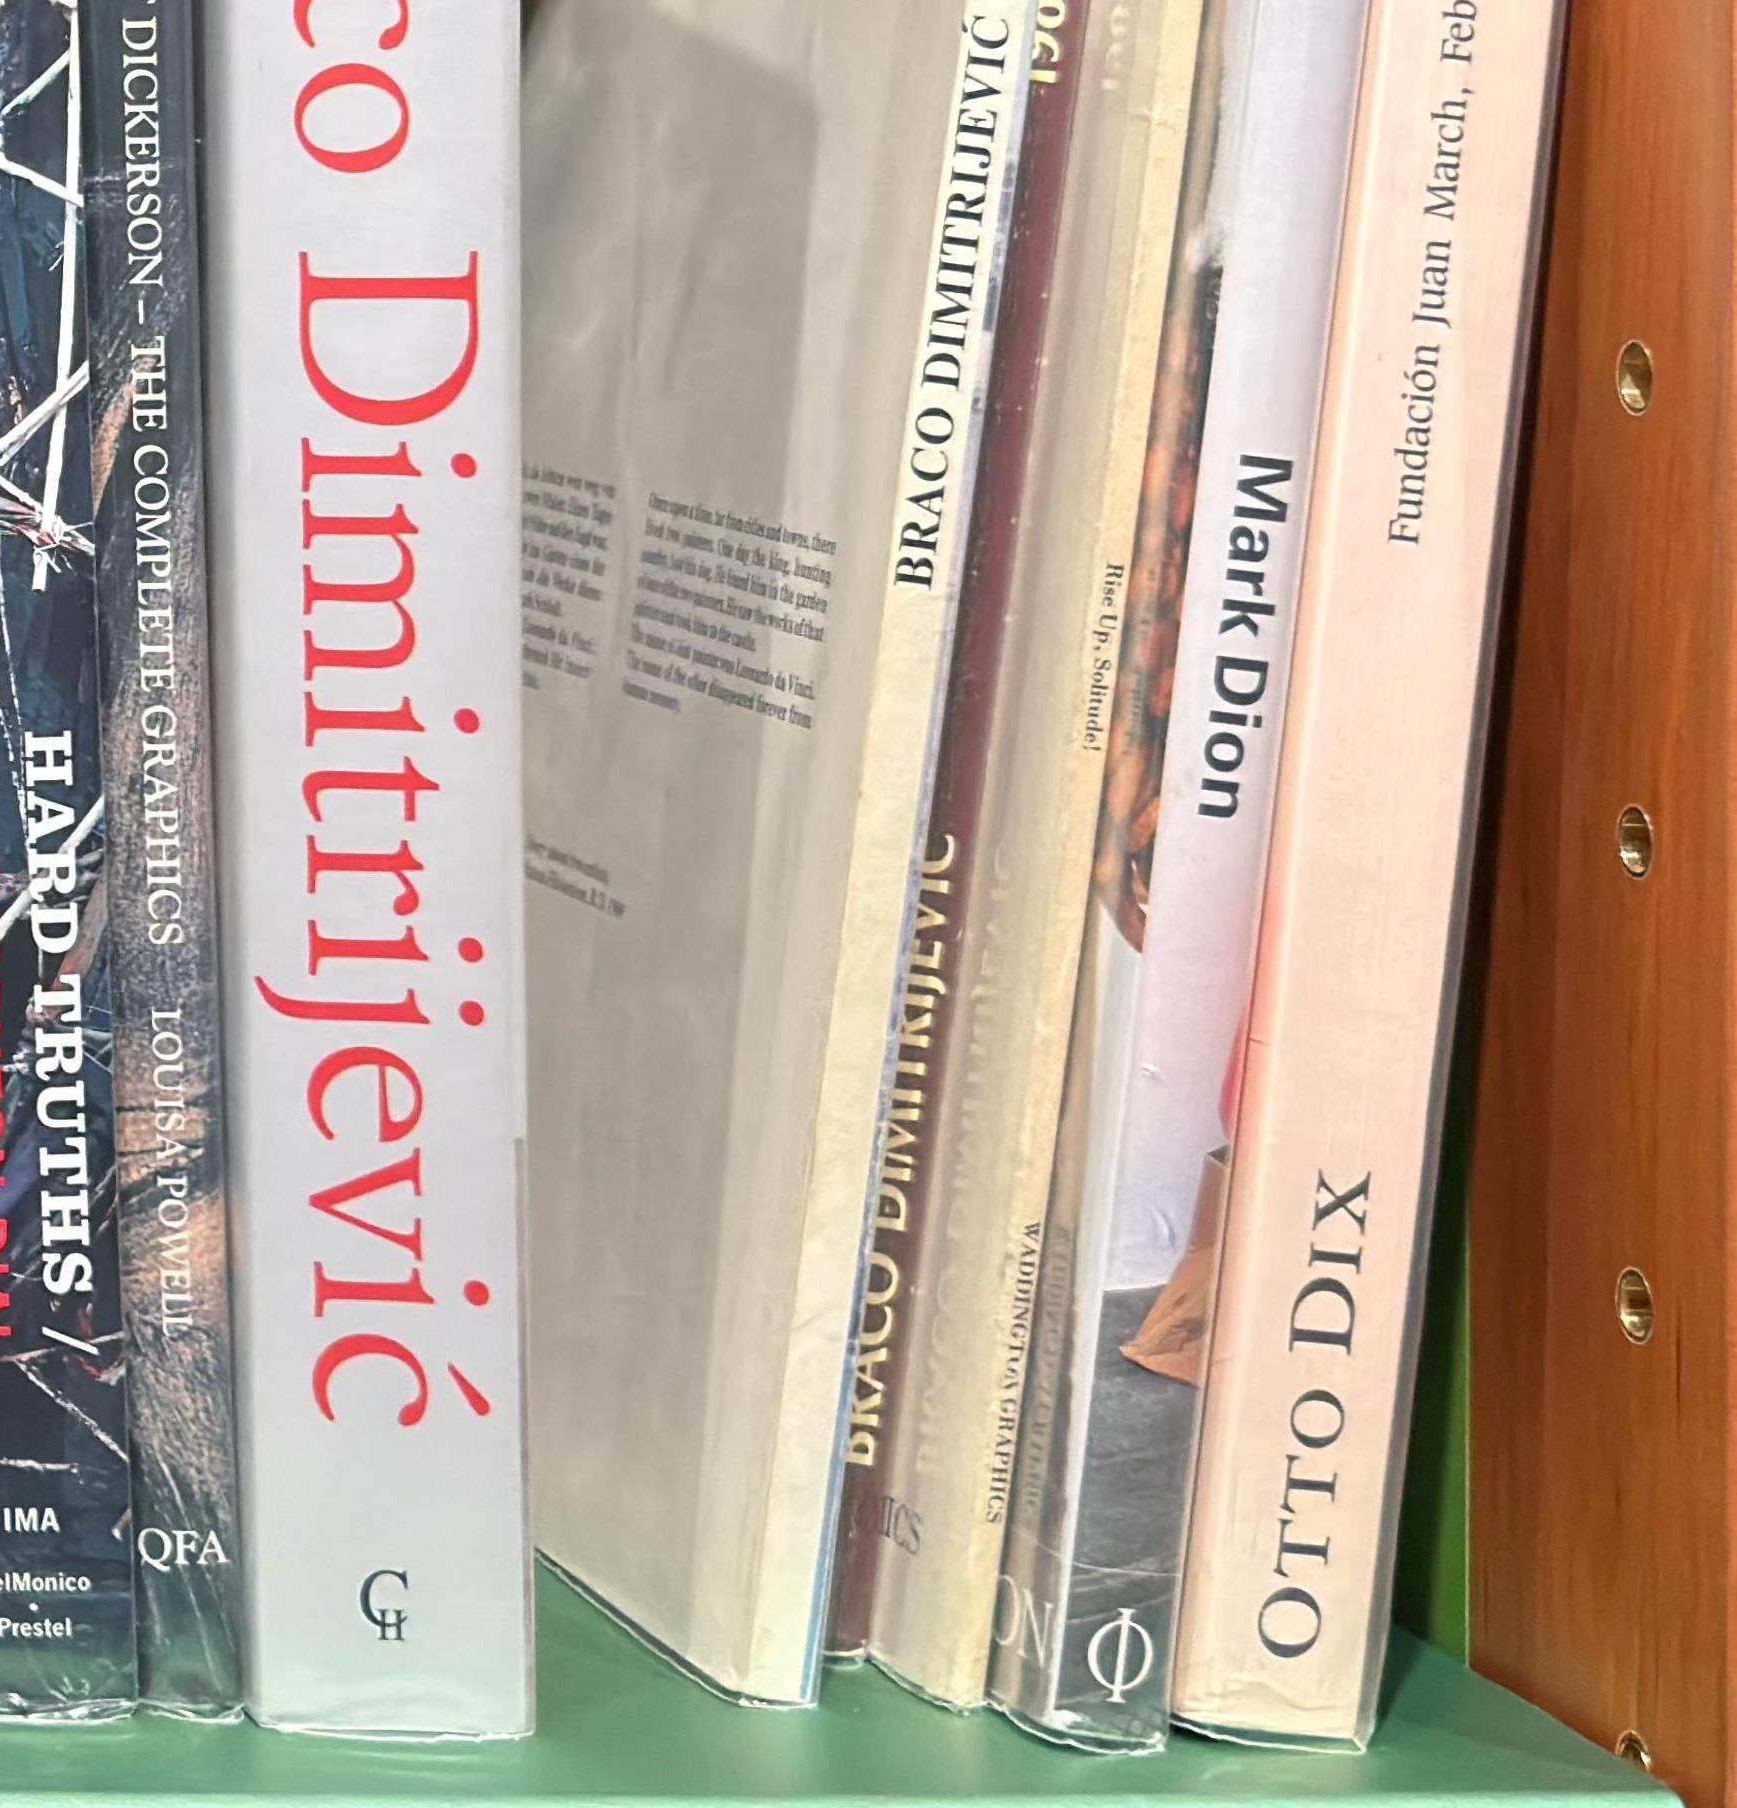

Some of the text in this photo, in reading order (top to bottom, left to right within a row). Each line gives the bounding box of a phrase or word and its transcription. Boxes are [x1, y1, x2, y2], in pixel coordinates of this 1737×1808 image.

[118, 17, 164, 288] DICKERSON
[1421, 88, 1475, 223] March,
[130, 335, 167, 431] THE
[893, 14, 1011, 592] BRACO DIMITRIJEVIĆ
[1411, 241, 1455, 329] Juan
[1386, 344, 1442, 547] Fundación
[133, 445, 179, 691] COMPLETE
[1082, 563, 1125, 752] Rise Up, Solitude!
[1197, 453, 1295, 818] Mark Dion
[141, 704, 184, 945] GRAPHICS
[252, 249, 488, 1425] Dimitrijević
[23, 730, 94, 1294] HARD TRUTHS
[2, 1506, 61, 1533] IMA
[985, 1397, 1017, 1525] GRAPHICS
[1257, 1169, 1372, 1660] OTTO DIX
[136, 1527, 228, 1573] QFA
